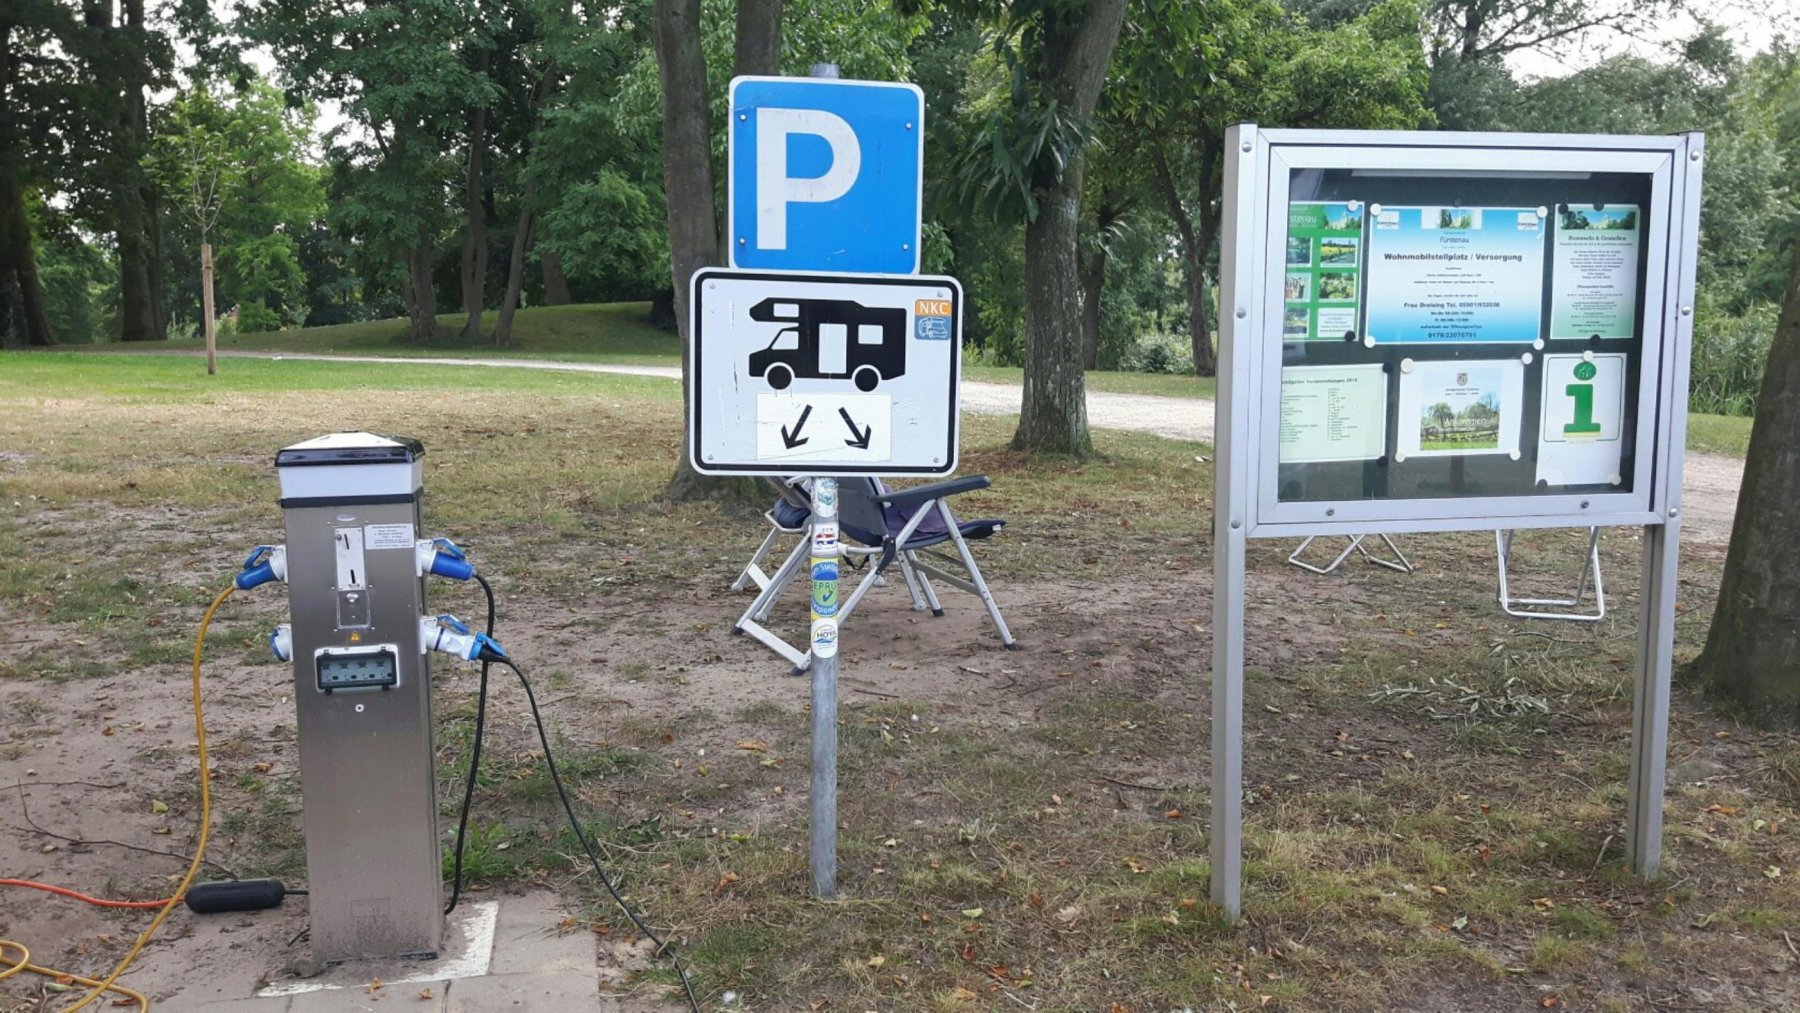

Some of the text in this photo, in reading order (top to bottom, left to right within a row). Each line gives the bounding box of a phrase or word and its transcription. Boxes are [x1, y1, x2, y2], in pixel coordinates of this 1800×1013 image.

[756, 107, 861, 250] P
[1439, 235, 1469, 243] Fürstenau
[1384, 253, 1468, 262] Wohnmobilstellplatz
[1475, 253, 1522, 262] Versorgung
[920, 301, 948, 315] NKC
